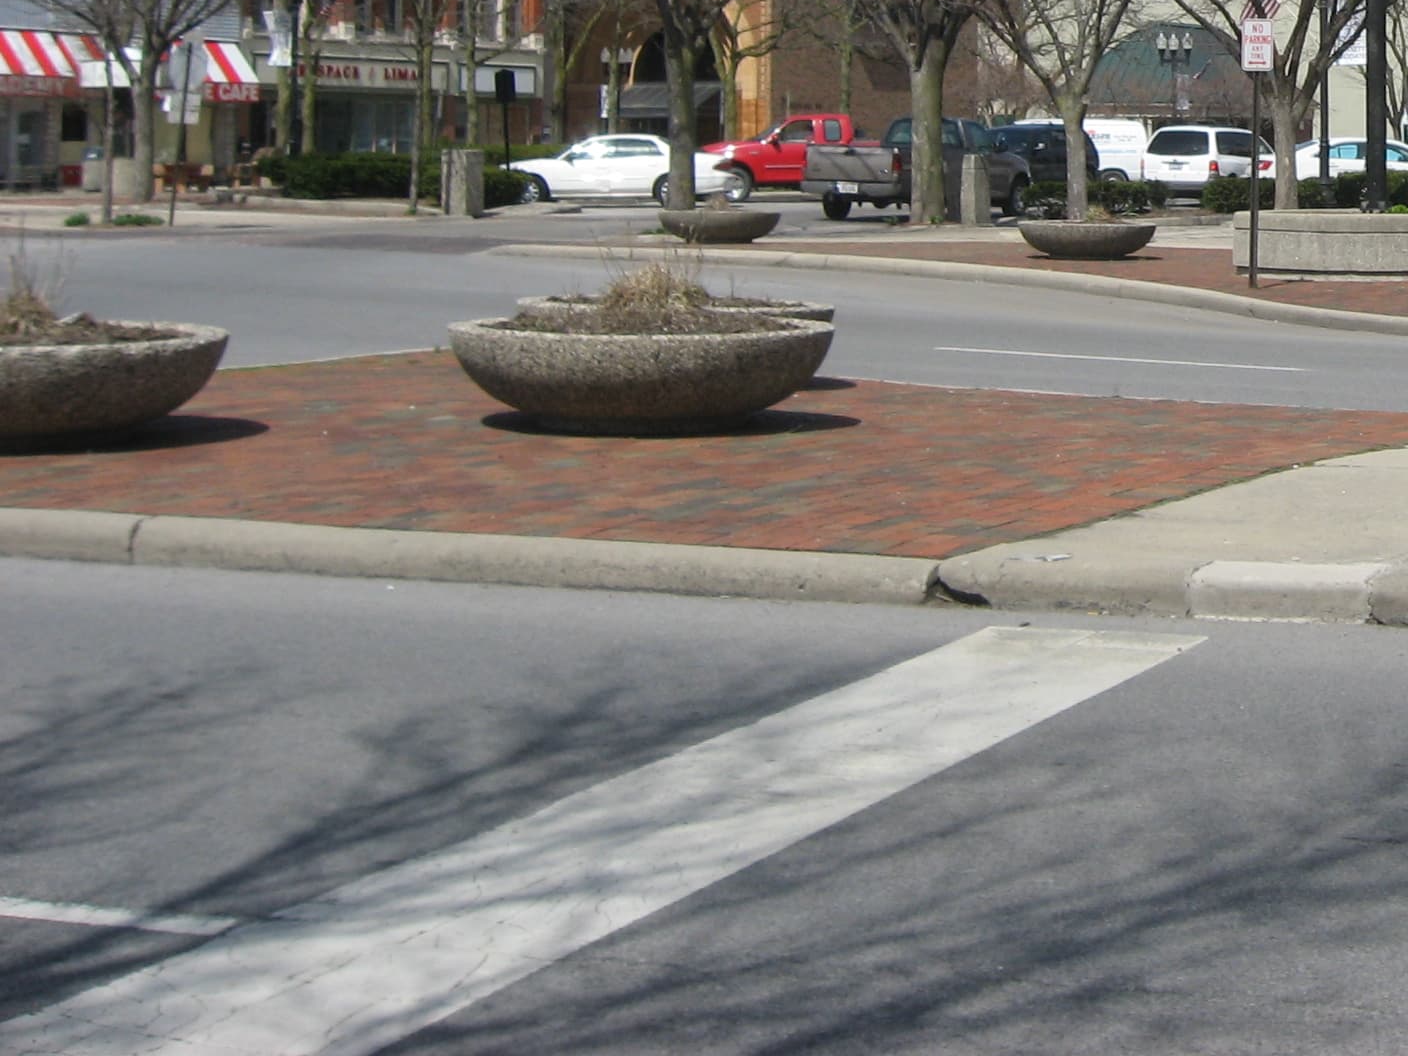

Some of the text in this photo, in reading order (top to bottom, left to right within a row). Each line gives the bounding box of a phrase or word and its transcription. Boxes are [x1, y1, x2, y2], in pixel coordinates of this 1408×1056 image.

[1252, 24, 1264, 34] NO
[1244, 35, 1272, 44] PARKING
[384, 68, 417, 81] LIMA
[219, 84, 259, 101] CAFE
